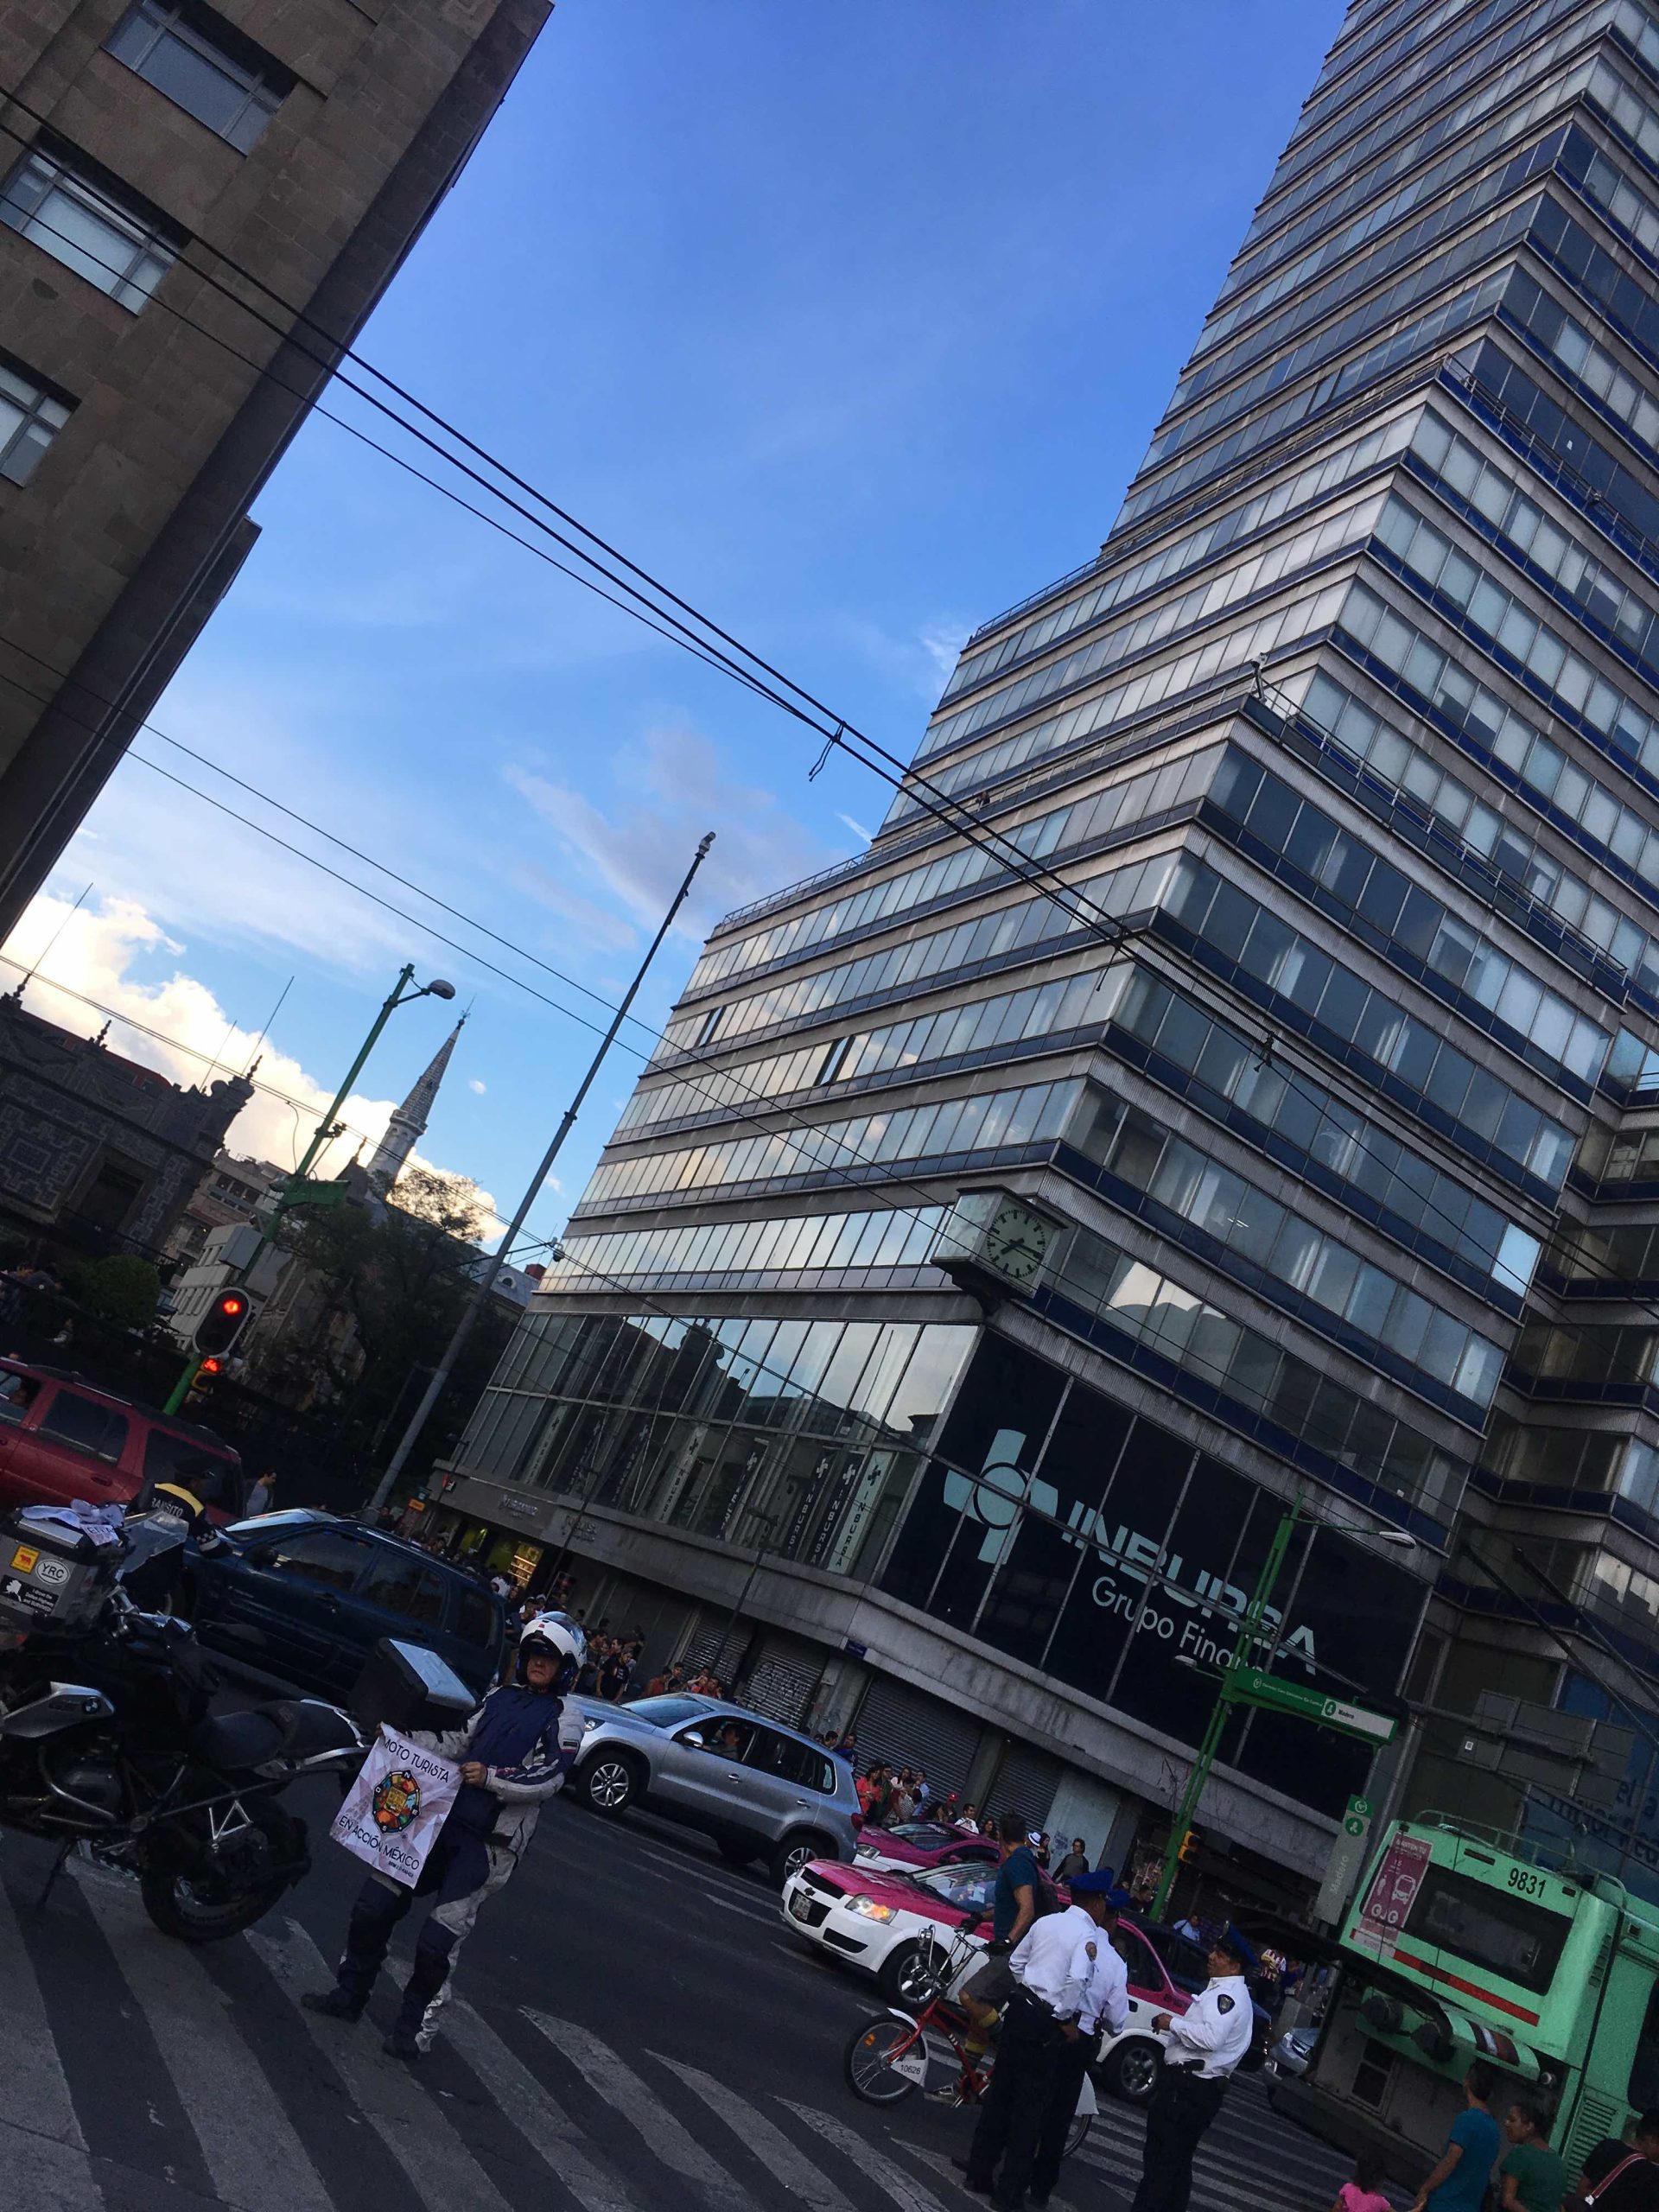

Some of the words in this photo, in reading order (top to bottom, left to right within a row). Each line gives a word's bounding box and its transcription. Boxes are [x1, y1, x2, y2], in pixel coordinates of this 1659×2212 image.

[810, 1489, 843, 1563] INBURSA
[835, 1491, 869, 1567] INBURSA
[41, 1562, 65, 1579] YRC
[1061, 1500, 1316, 1675] INBURSA
[1092, 1576, 1173, 1639] Grupo
[411, 1753, 448, 1783] TURISTA
[339, 1815, 353, 1831] EN
[352, 1825, 383, 1852] ACCIÓN
[384, 1846, 420, 1871] MÉXICO
[1329, 1855, 1349, 1894] Madero
[1508, 1868, 1547, 1899] 9831
[900, 2063, 921, 2075] 10626
